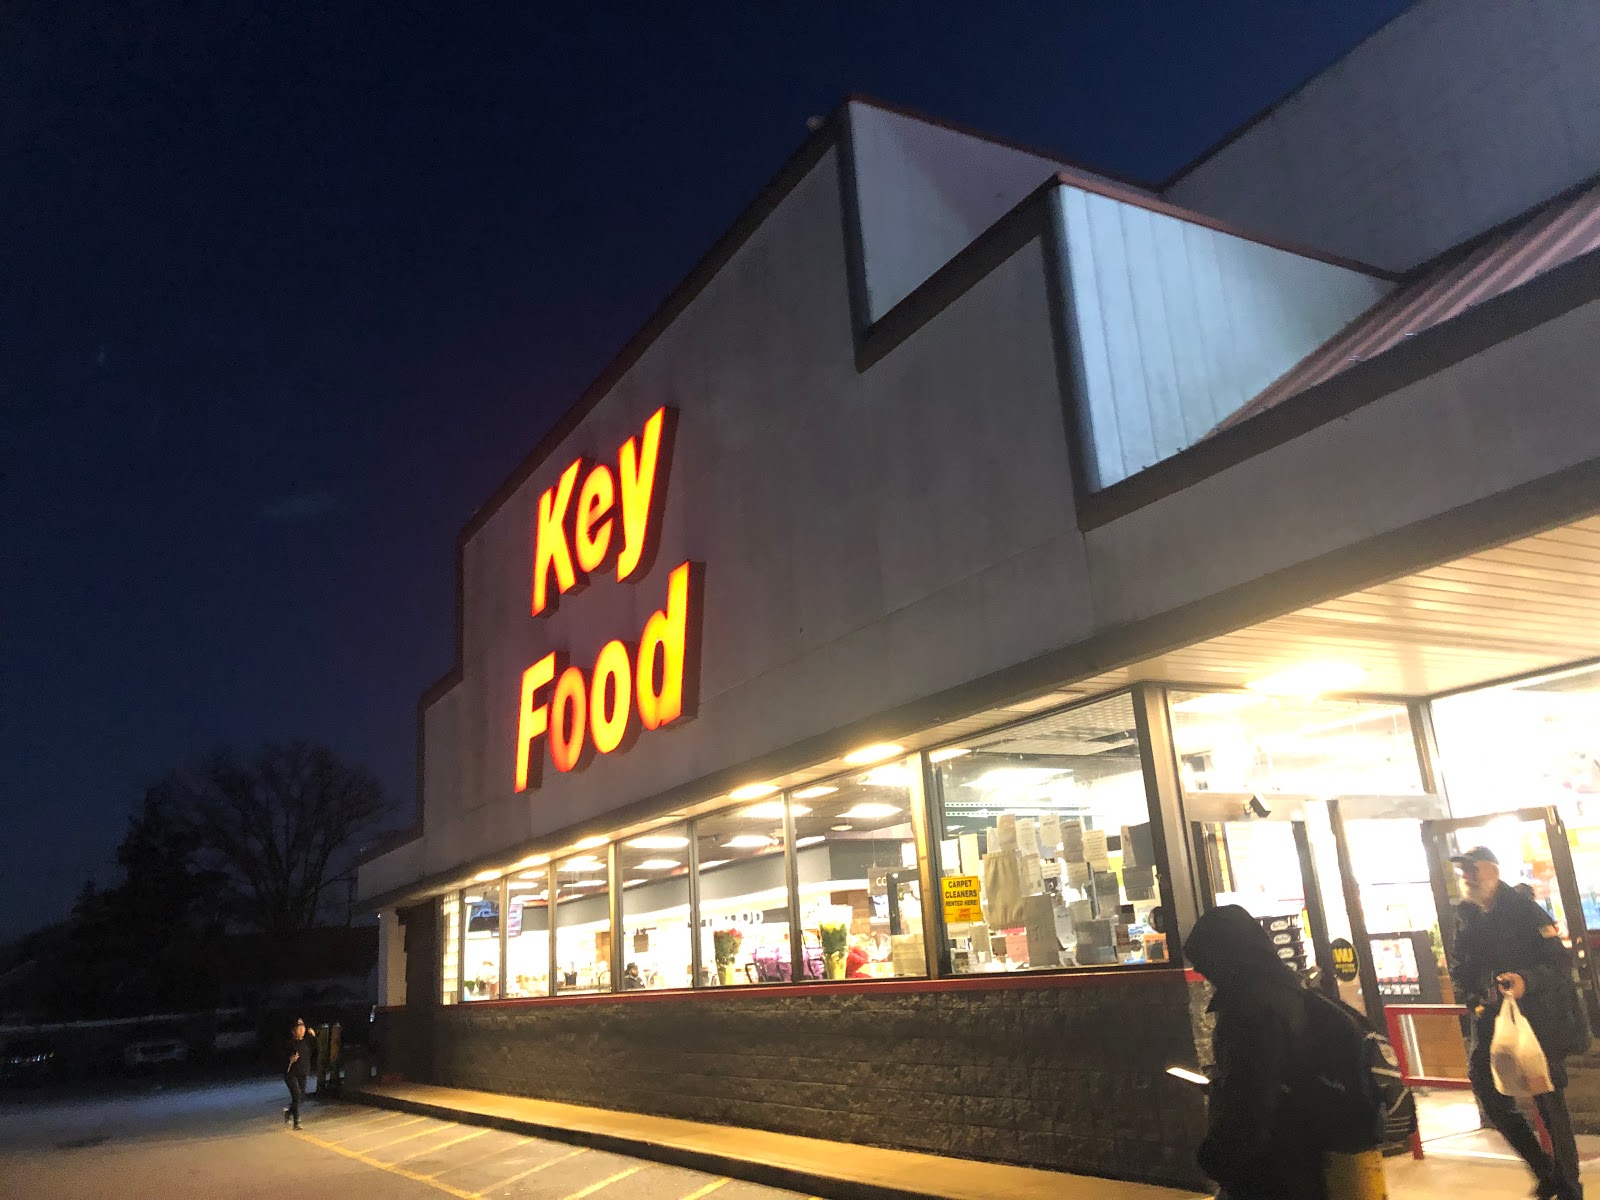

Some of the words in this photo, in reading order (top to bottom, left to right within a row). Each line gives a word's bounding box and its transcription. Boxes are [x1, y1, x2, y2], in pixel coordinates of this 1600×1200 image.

[531, 406, 666, 618] Key
[514, 561, 690, 794] Food
[945, 890, 977, 898] CLEANERS
[948, 880, 972, 888] CARPET
